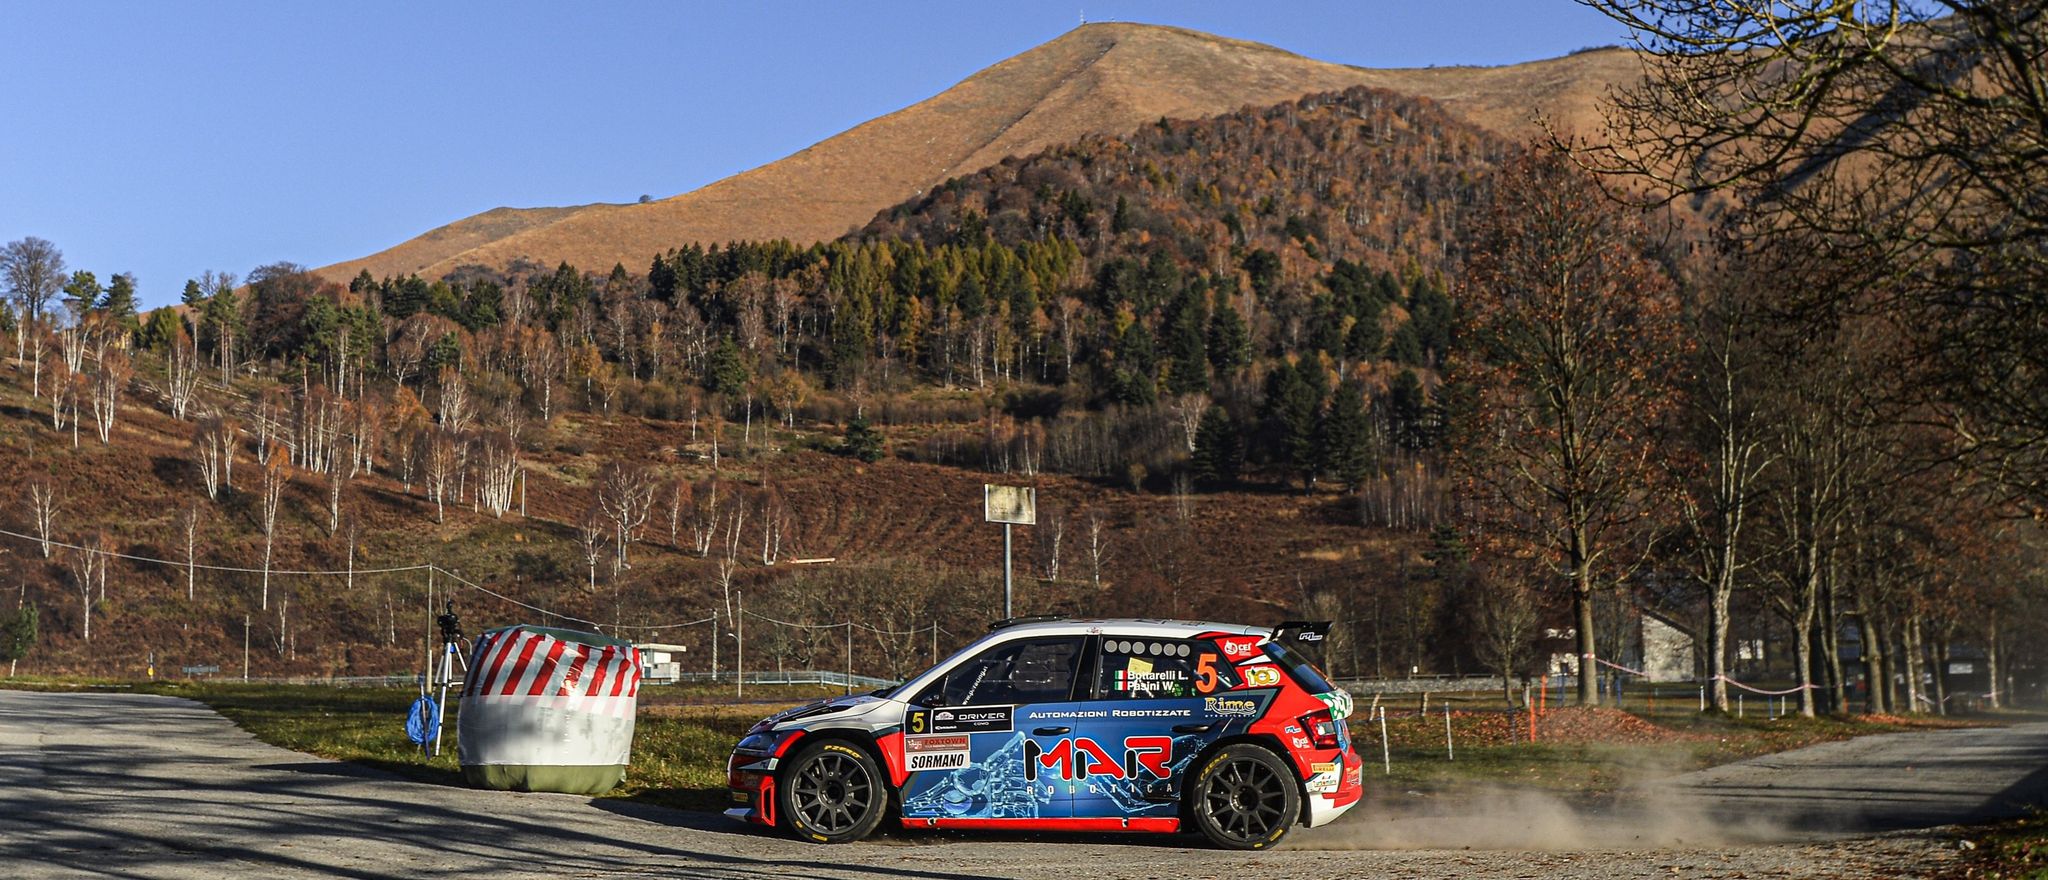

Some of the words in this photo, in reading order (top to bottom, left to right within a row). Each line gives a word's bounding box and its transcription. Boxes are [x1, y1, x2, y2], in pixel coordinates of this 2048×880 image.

[1127, 670, 1176, 680] Bottarelli
[1178, 670, 1189, 680] L.
[1195, 653, 1218, 694] 5
[1127, 681, 1160, 691] Pasini
[1162, 681, 1176, 692] W.
[1204, 697, 1257, 715] Rime
[911, 712, 925, 733] 5
[958, 712, 1006, 720] DRIVER
[911, 753, 965, 769] SORMANO
[1024, 736, 1173, 782] MAR
[1026, 784, 1173, 795] ROBOTICA
